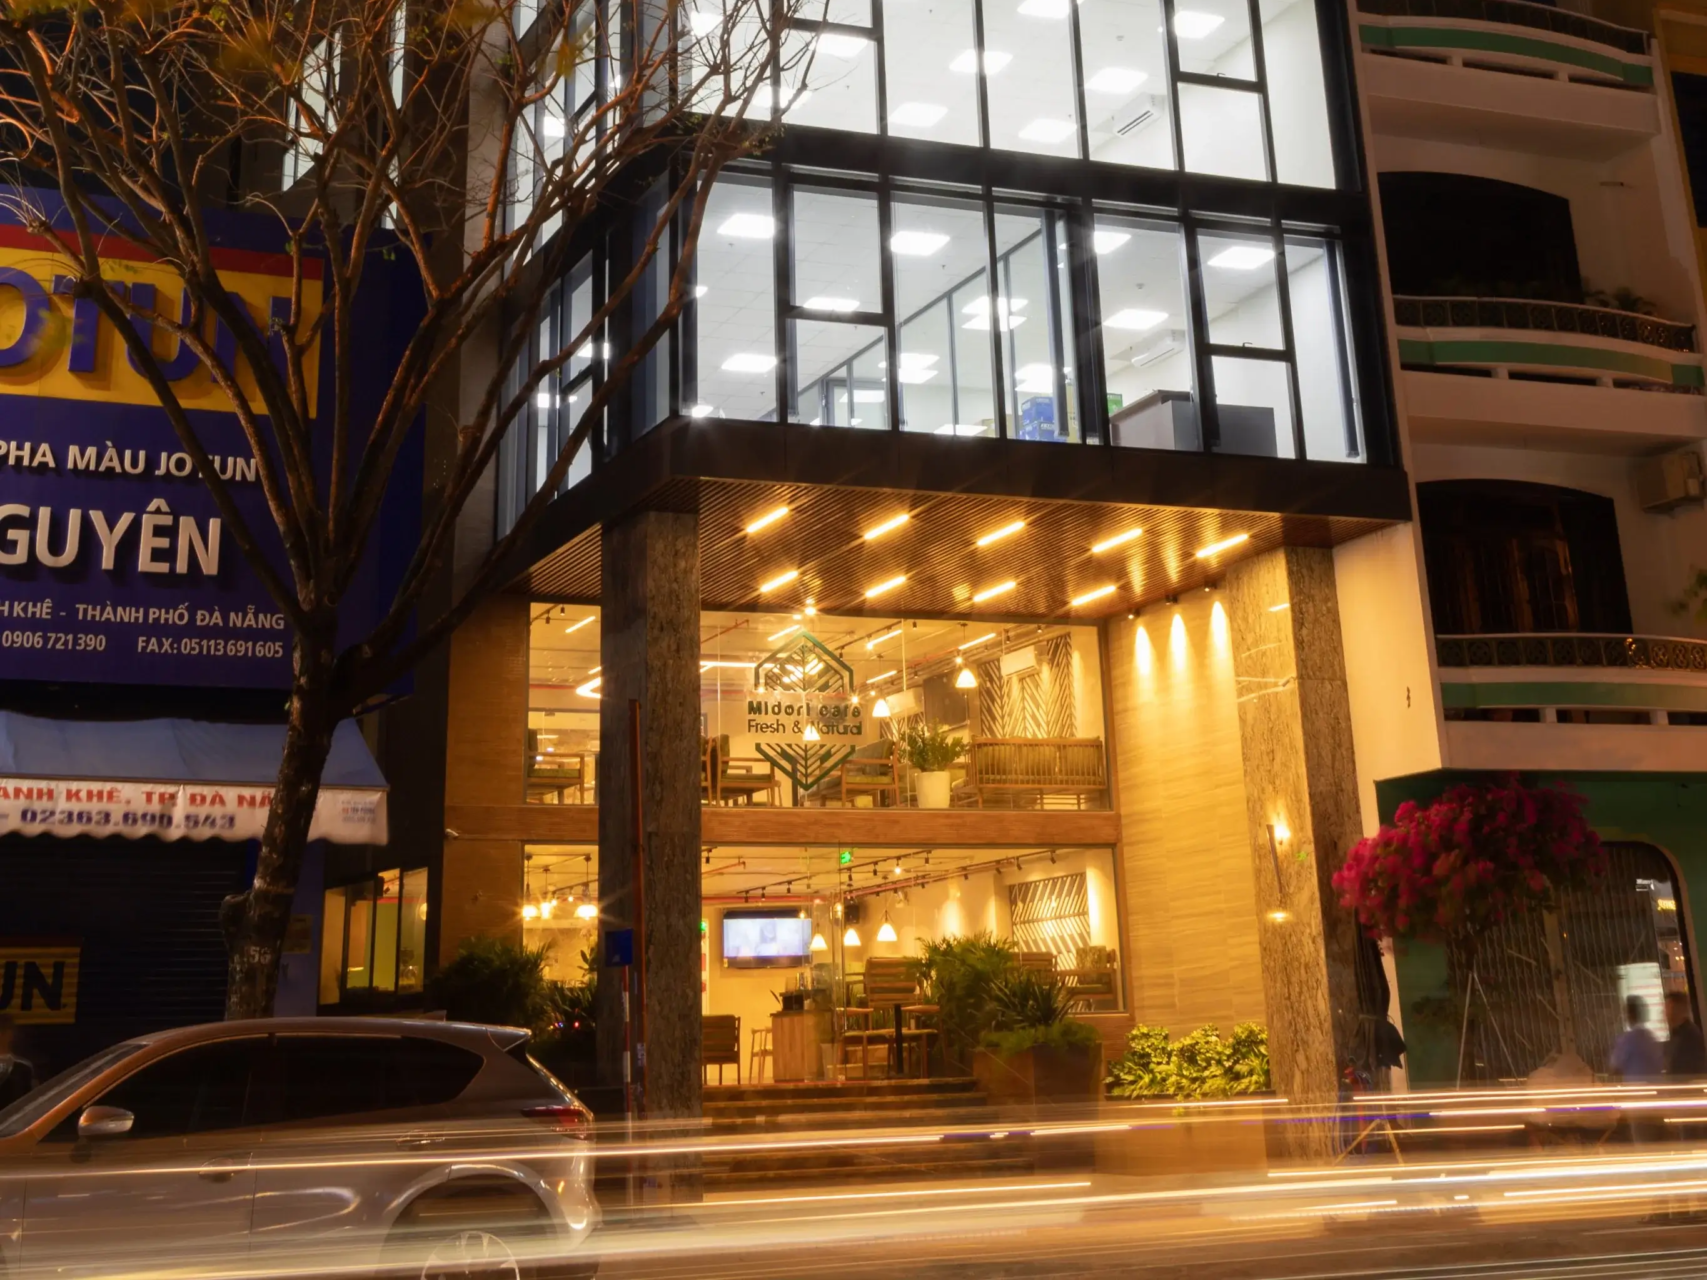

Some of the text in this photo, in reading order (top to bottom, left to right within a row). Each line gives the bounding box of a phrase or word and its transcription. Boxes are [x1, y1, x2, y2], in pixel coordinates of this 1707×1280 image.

[67, 441, 146, 474] MÀU
[0, 498, 221, 576] GUYÊN
[13, 598, 52, 619] KHÊ
[76, 600, 143, 623] THÀNH
[149, 602, 188, 625] PHỐ
[196, 606, 223, 626] ĐÀ
[137, 636, 178, 654] FAX:
[748, 719, 786, 734] Fresh
[792, 720, 804, 734] &
[189, 791, 226, 807] ĐÀ
